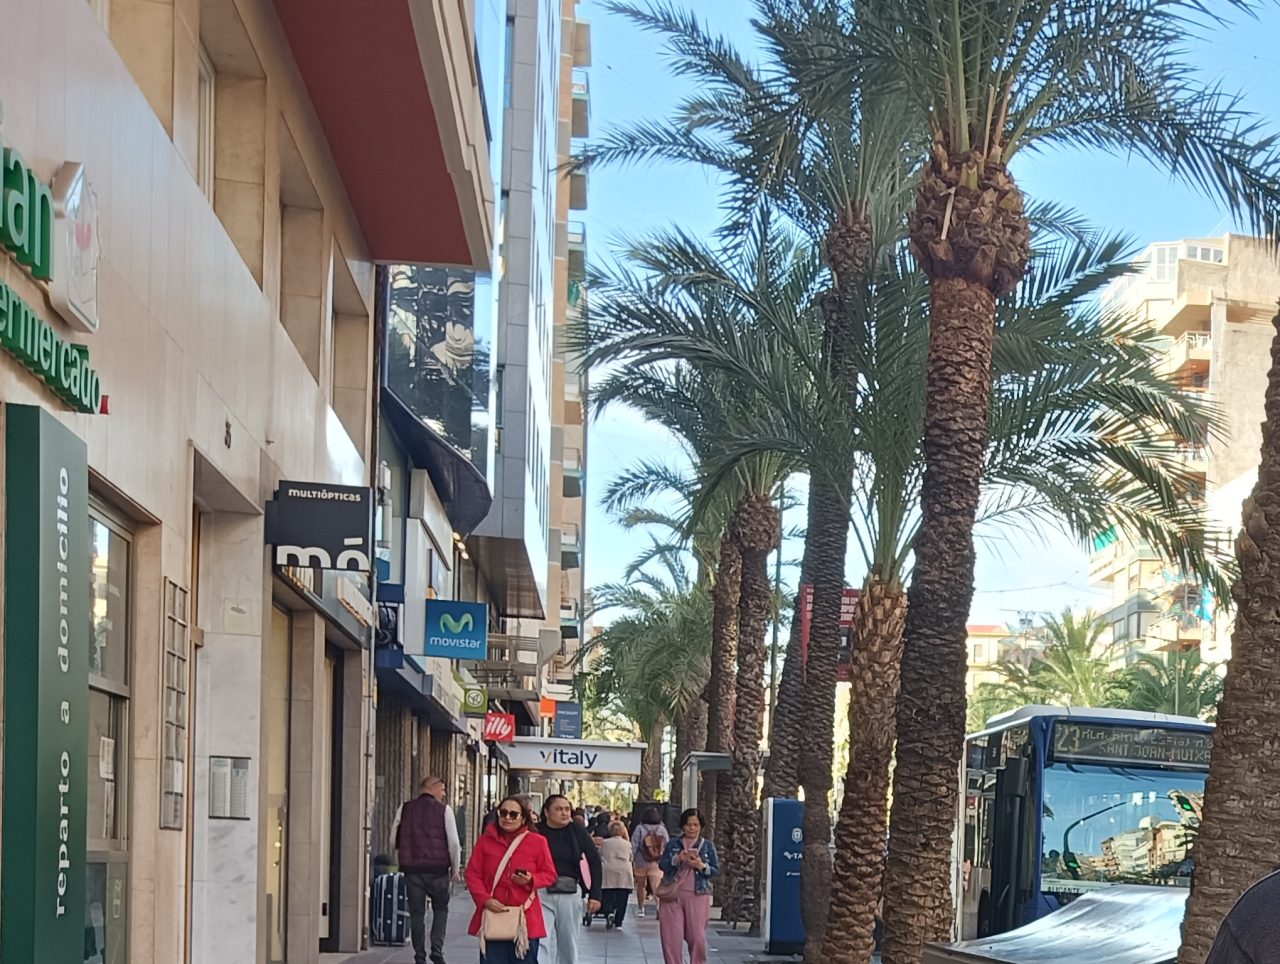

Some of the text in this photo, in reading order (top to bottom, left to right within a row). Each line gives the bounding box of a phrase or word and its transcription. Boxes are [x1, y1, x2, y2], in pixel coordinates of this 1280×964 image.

[429, 636, 481, 650] movistar
[55, 466, 71, 919] reparto a domicilio
[485, 716, 512, 739] illy
[1056, 725, 1080, 753] 23
[539, 748, 598, 769] vitaly
